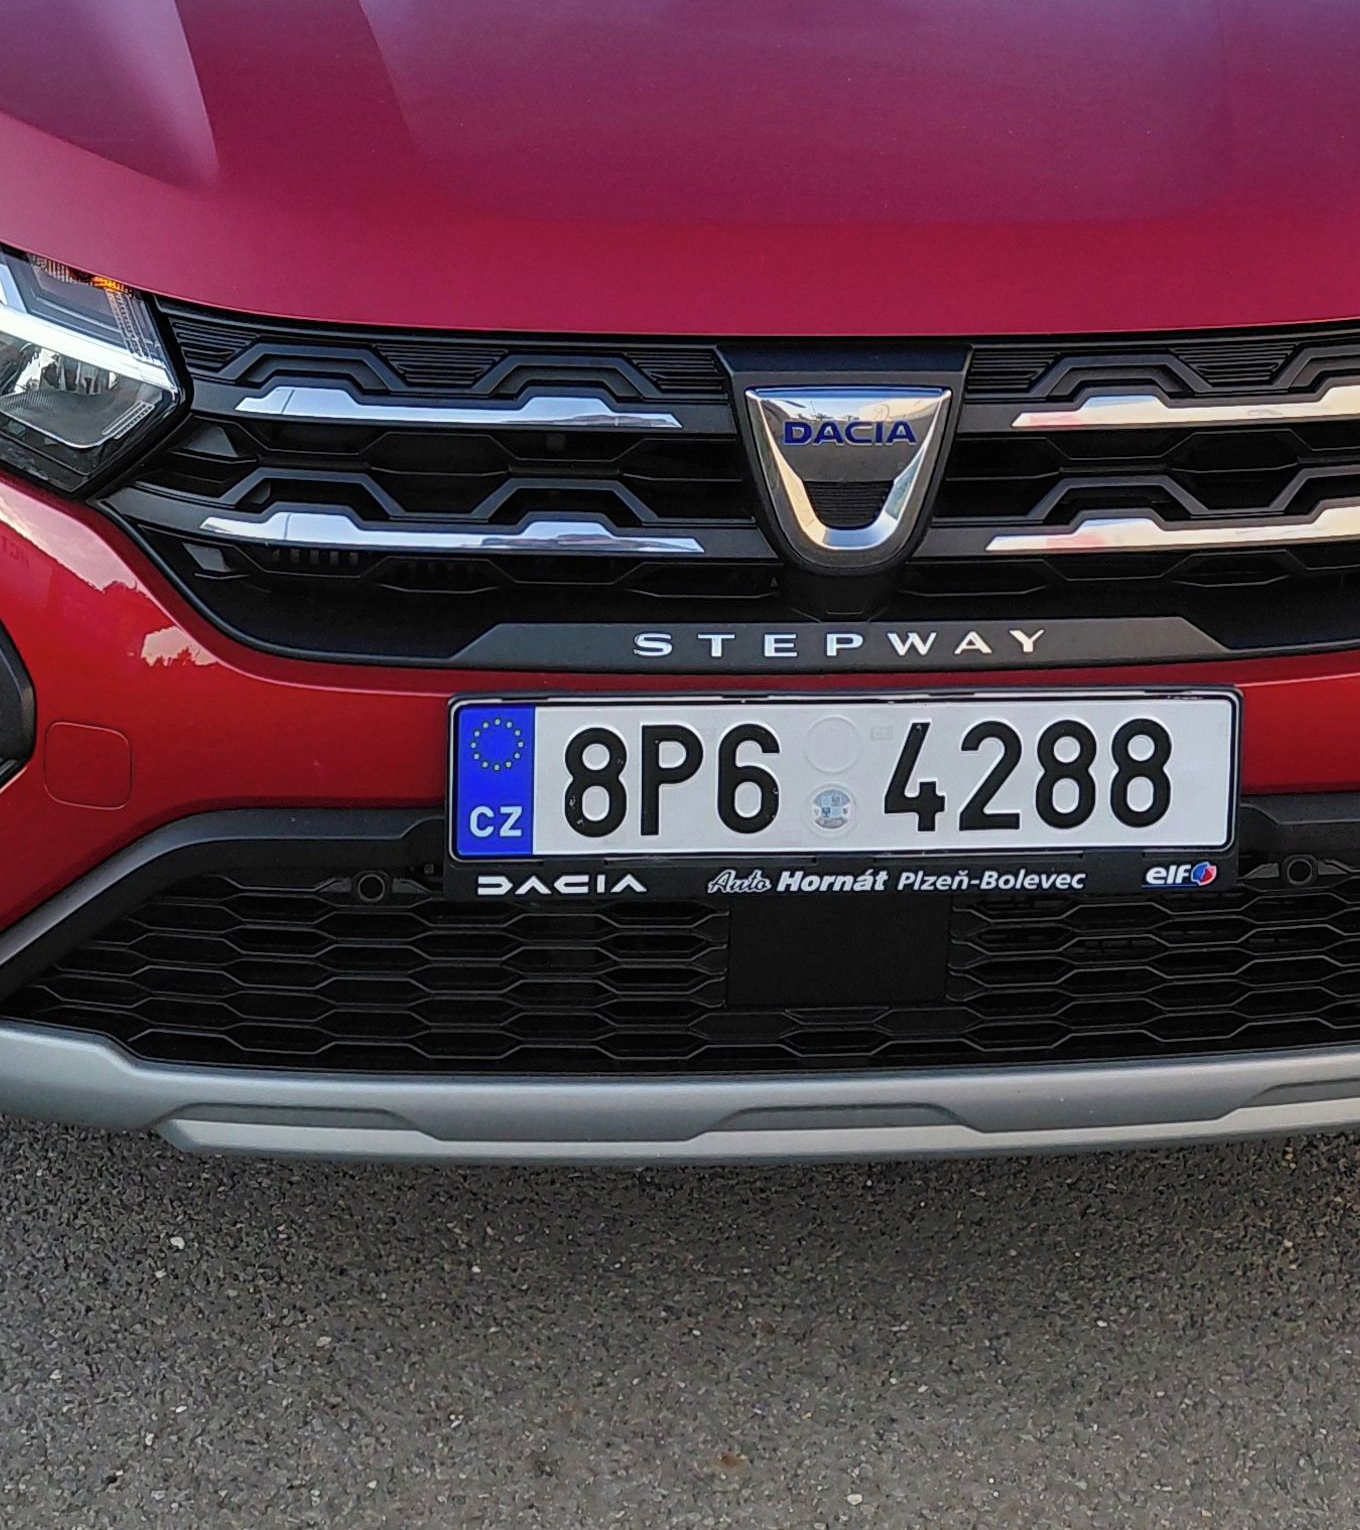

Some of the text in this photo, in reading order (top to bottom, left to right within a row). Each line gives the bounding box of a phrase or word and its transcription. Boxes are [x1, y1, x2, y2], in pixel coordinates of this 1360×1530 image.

[781, 420, 918, 447] DACIA
[633, 628, 1047, 659] STEPWAY
[562, 716, 1173, 839] 8P6 4288
[469, 804, 524, 839] CZ
[476, 873, 648, 895] DACIA
[706, 867, 1086, 893] Auto Hornát Plzeň-Bolevec
